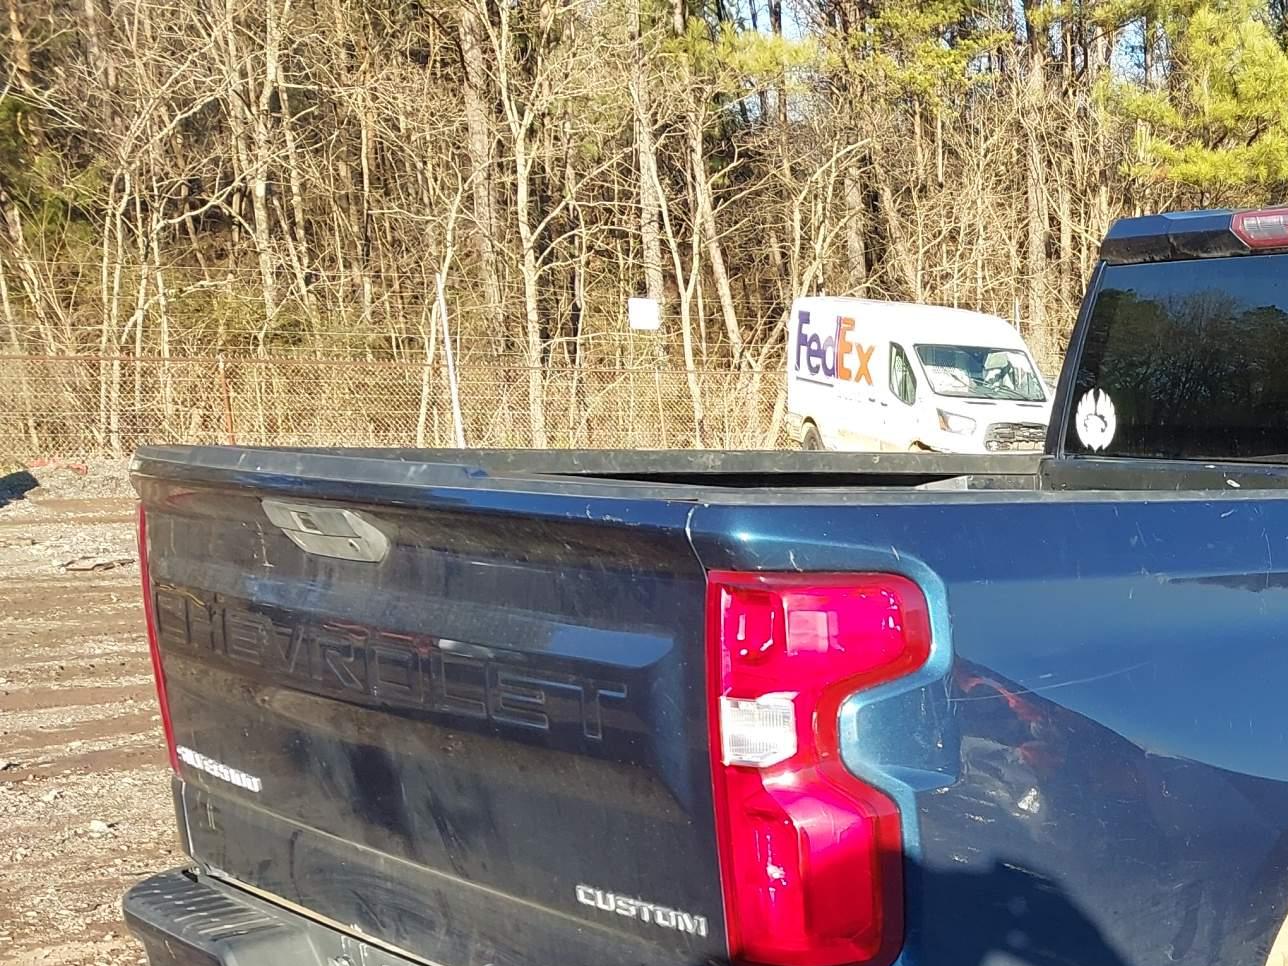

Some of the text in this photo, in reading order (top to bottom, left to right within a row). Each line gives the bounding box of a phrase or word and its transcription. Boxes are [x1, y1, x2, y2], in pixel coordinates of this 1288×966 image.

[795, 310, 877, 386] FedEx
[155, 588, 628, 741] CHEVROLET
[575, 884, 709, 937] CUSTOM
